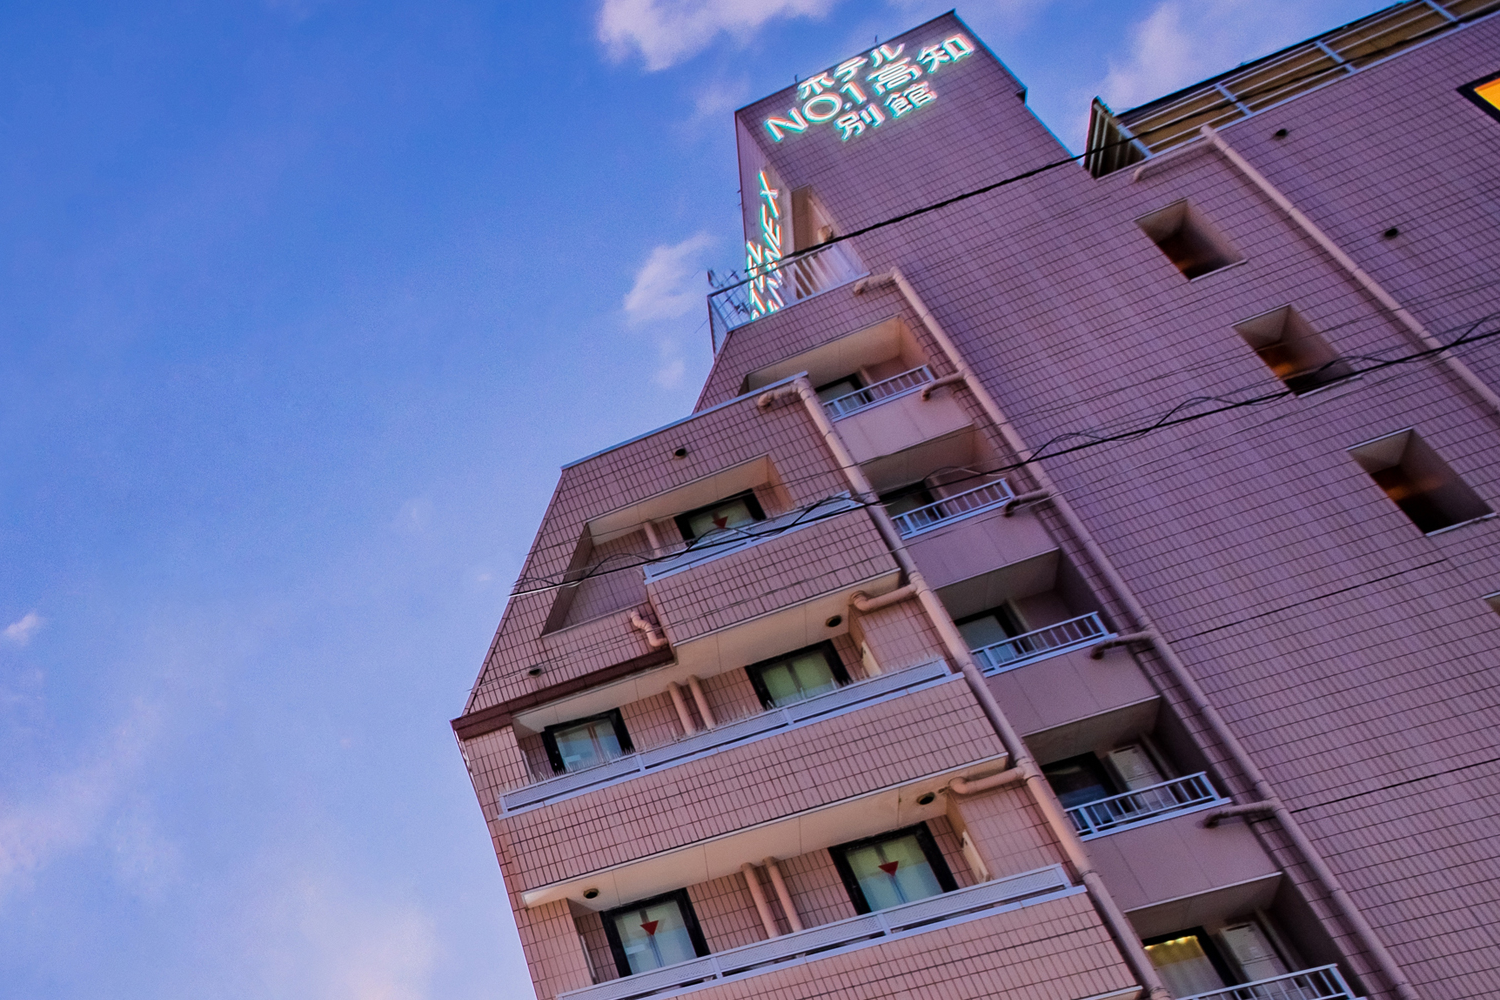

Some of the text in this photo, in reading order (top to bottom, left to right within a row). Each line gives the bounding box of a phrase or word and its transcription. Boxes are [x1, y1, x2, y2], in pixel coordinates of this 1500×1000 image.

[797, 43, 905, 99] ホテル
[834, 81, 937, 141] 別館
